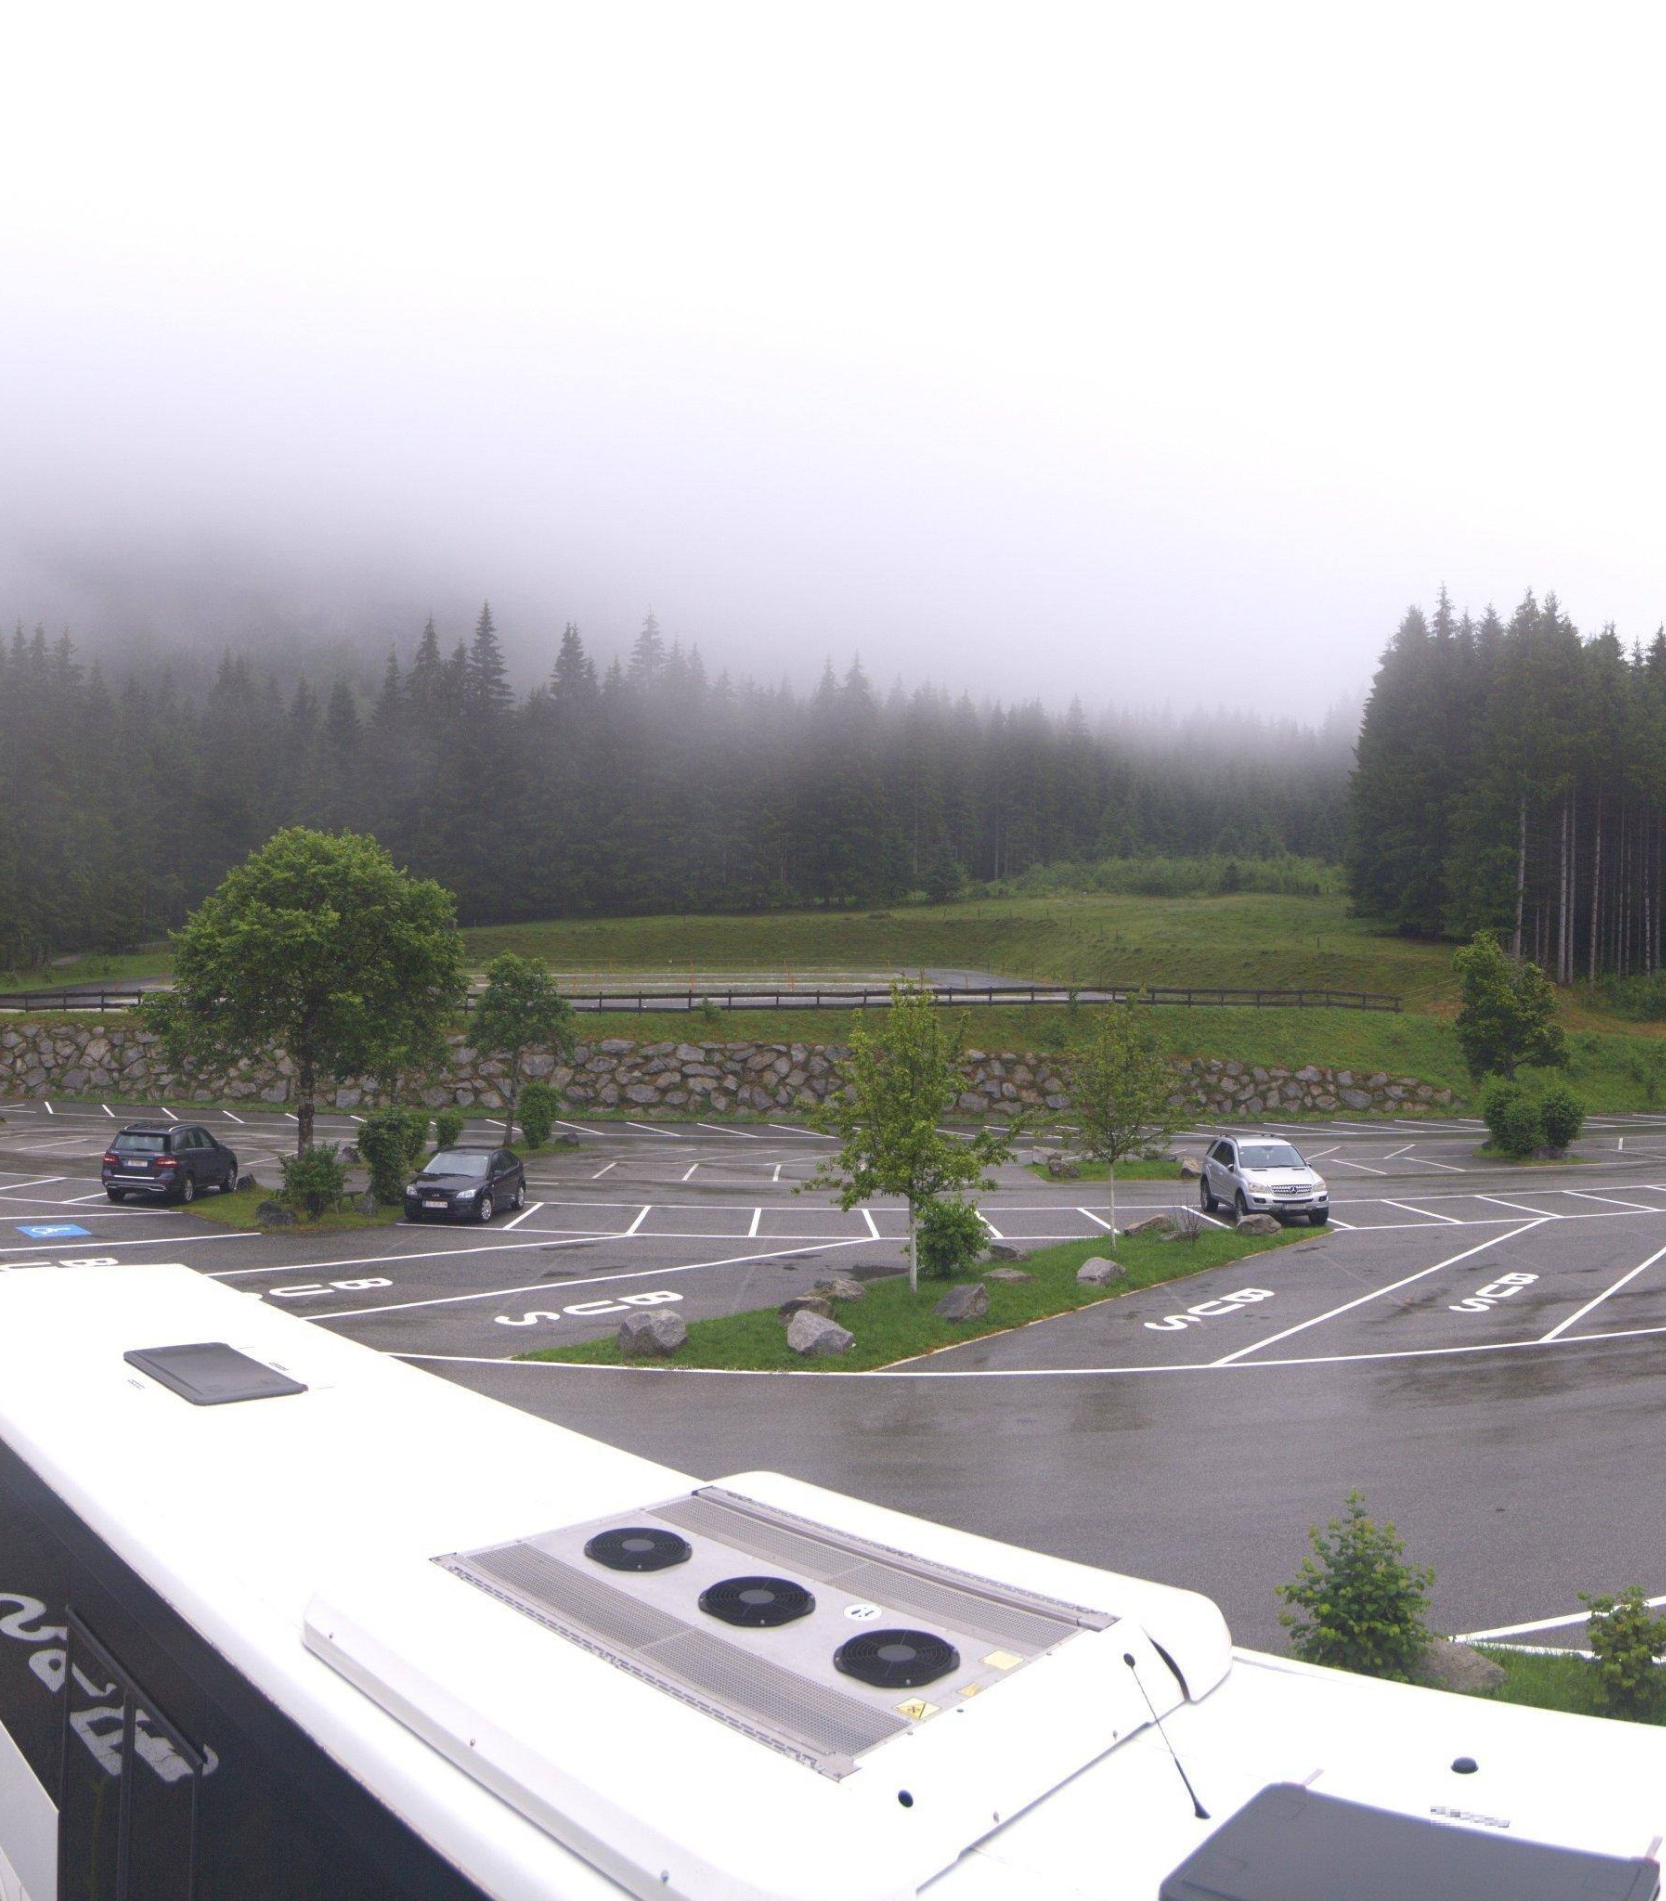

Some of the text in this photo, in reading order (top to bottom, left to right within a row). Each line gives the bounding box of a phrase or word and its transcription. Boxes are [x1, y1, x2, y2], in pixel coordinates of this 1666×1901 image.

[494, 1290, 684, 1326] BUS
[1143, 1287, 1276, 1332] BUS
[1448, 1272, 1540, 1312] BUS
